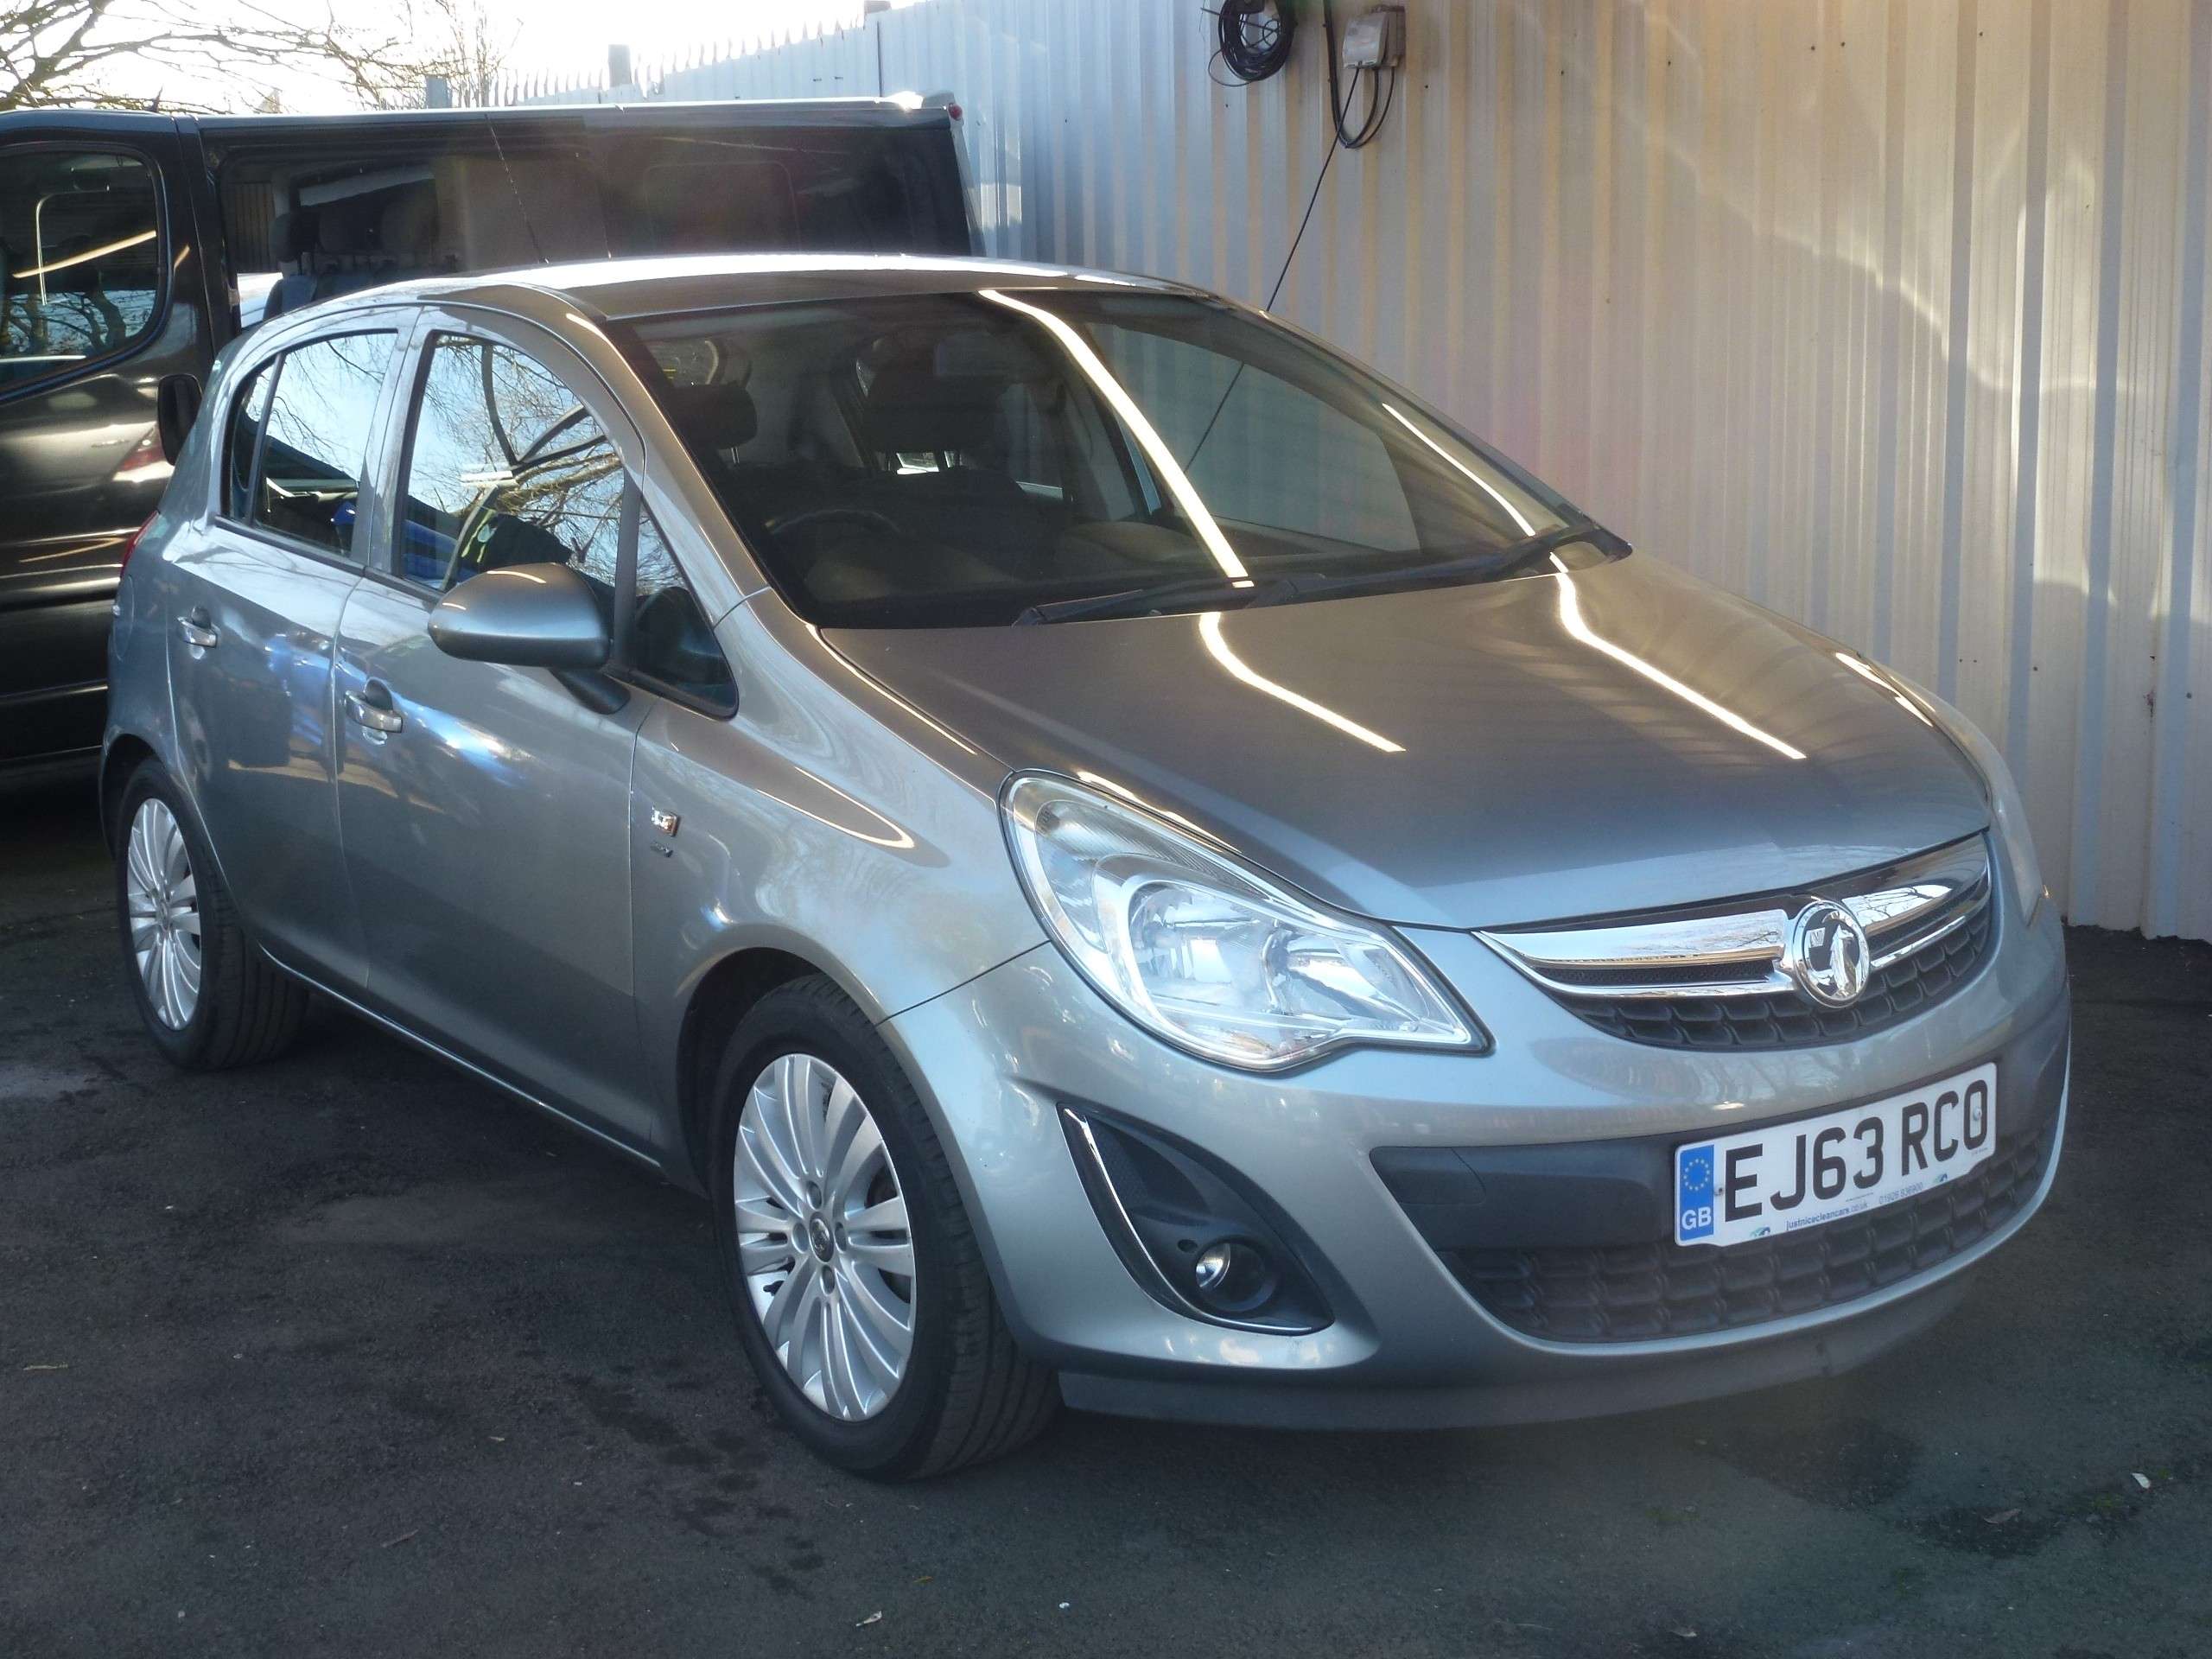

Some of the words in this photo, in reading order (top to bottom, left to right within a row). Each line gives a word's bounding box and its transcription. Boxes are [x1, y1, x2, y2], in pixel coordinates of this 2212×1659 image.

[1725, 1116, 1885, 1223] EJ63
[1901, 1079, 1988, 1177] RCO
[1681, 1206, 1712, 1230] GB
